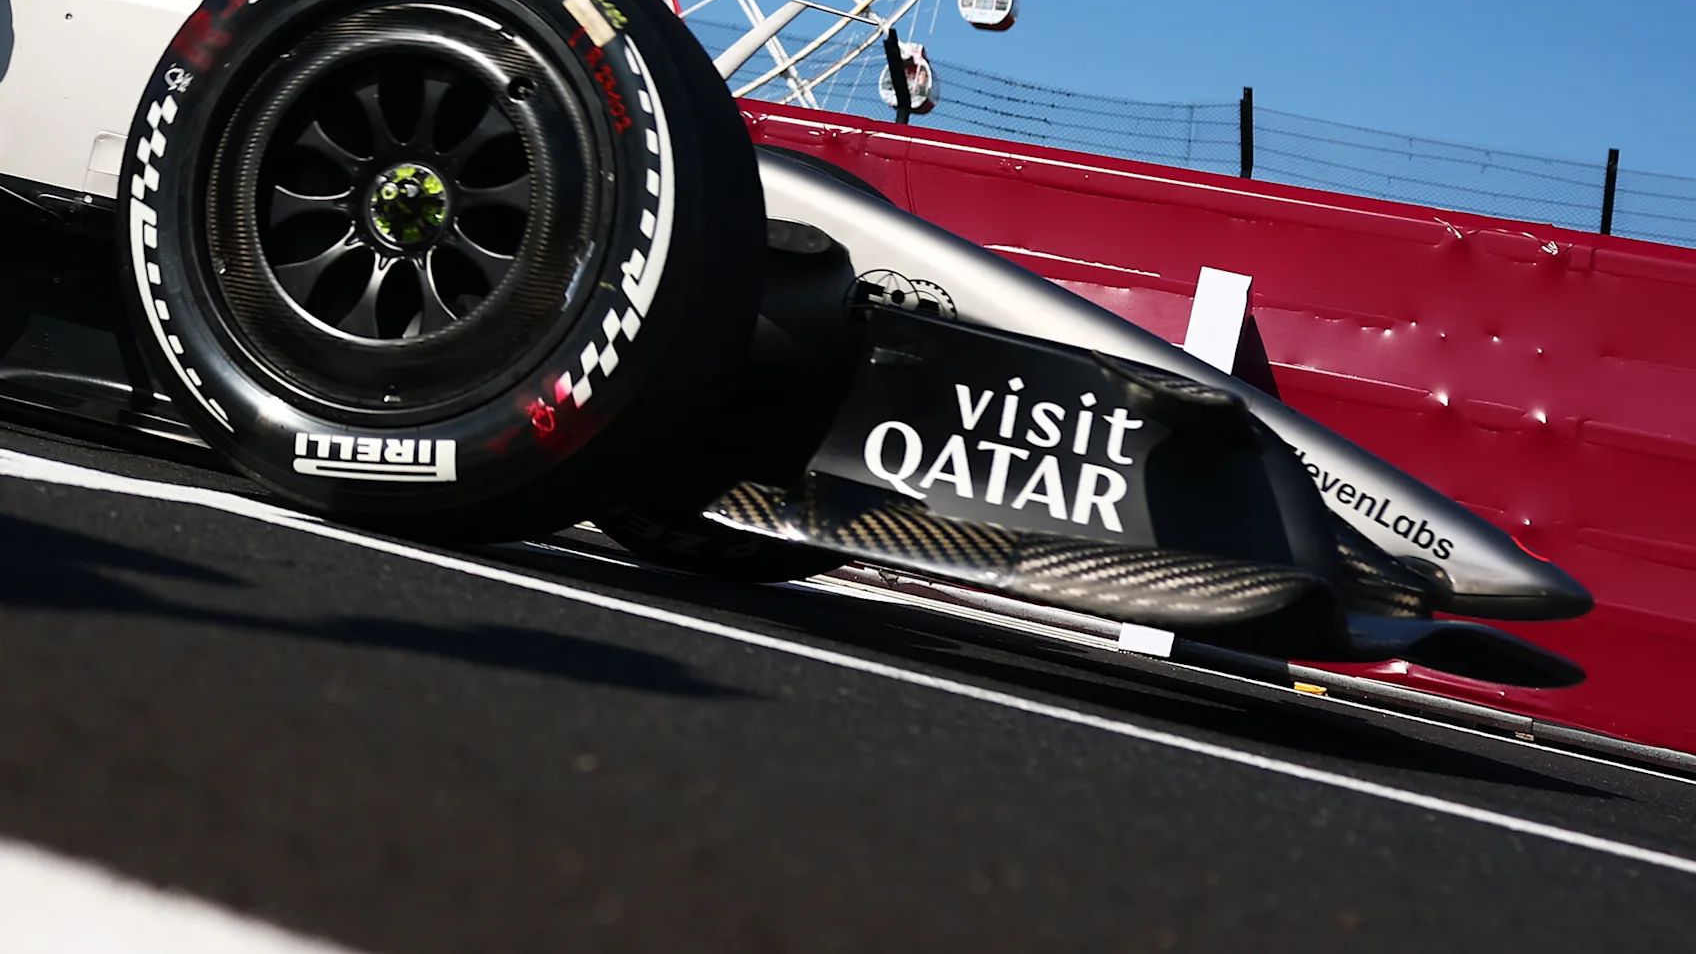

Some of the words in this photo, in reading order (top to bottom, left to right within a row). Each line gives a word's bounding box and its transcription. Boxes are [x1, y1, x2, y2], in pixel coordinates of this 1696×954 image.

[292, 432, 457, 482] PIRELLI
[954, 376, 1144, 465] visit
[864, 420, 1128, 533] QATAR
[1291, 448, 1454, 560] evenLabs
